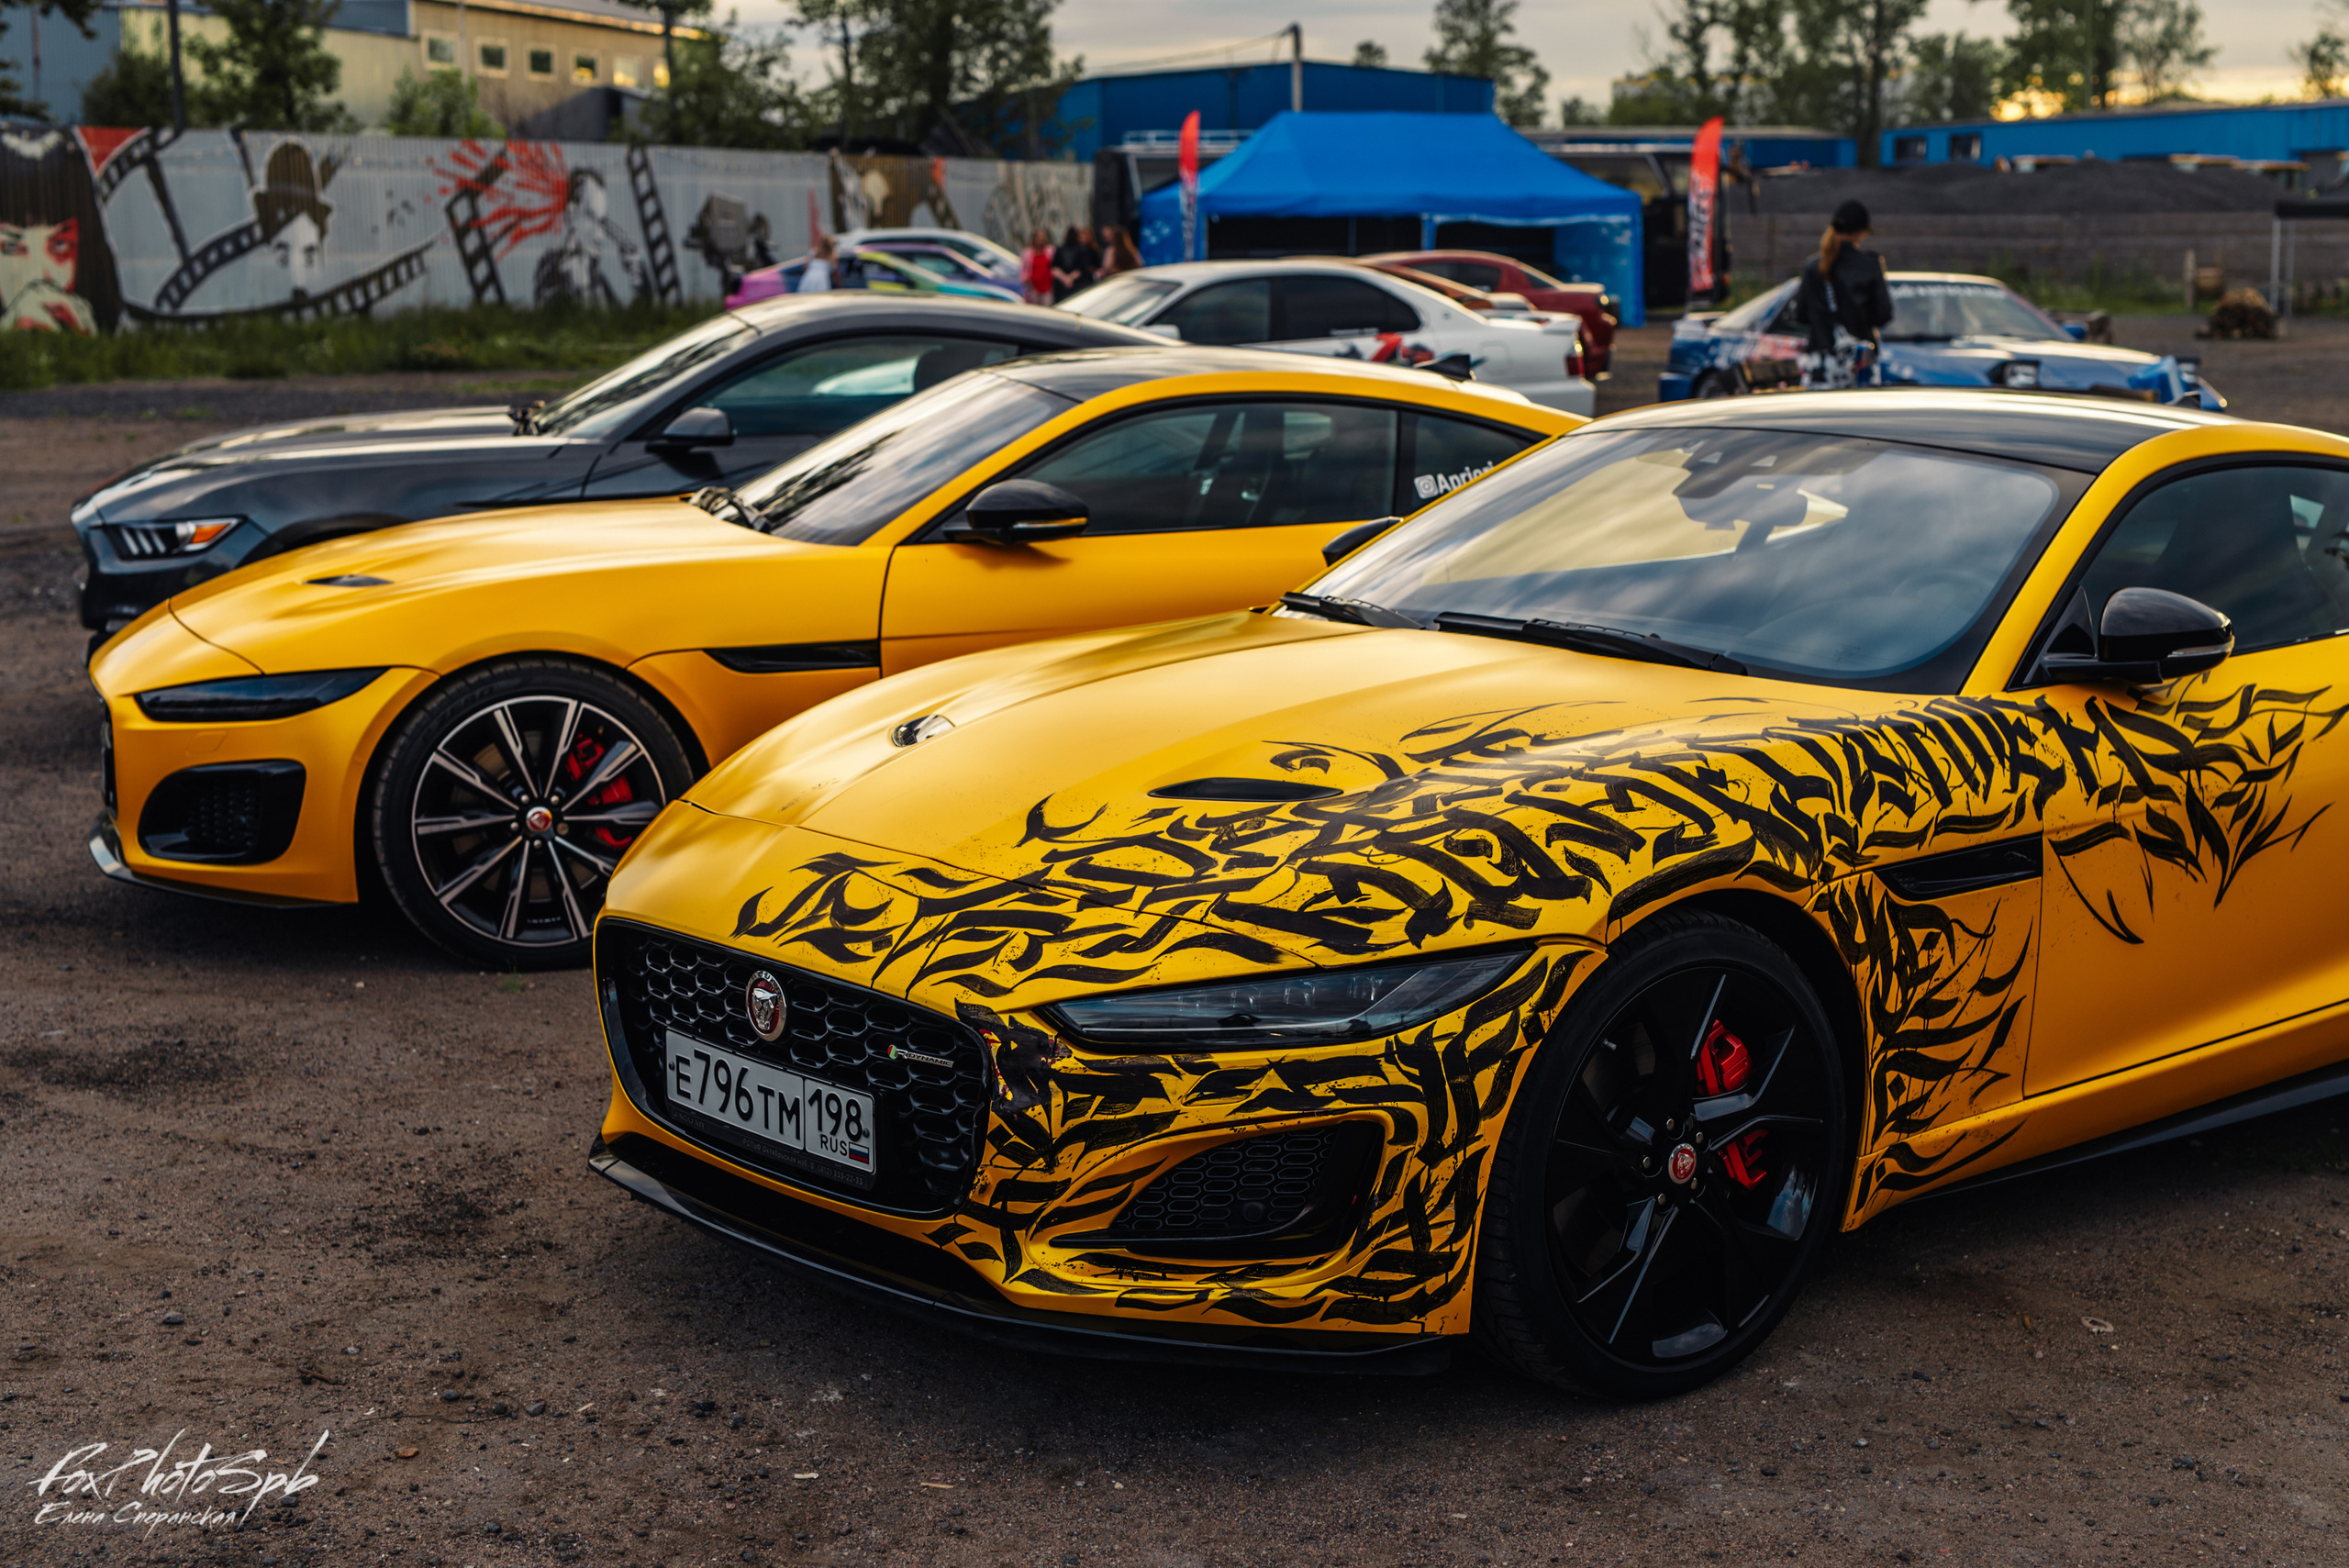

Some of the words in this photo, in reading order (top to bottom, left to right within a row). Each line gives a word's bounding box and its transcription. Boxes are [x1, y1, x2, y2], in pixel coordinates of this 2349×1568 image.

[1437, 461, 1494, 494] Aprio
[674, 1111, 706, 1130] JAGUAR
[808, 1088, 863, 1143] 198
[819, 1134, 848, 1156] RUS
